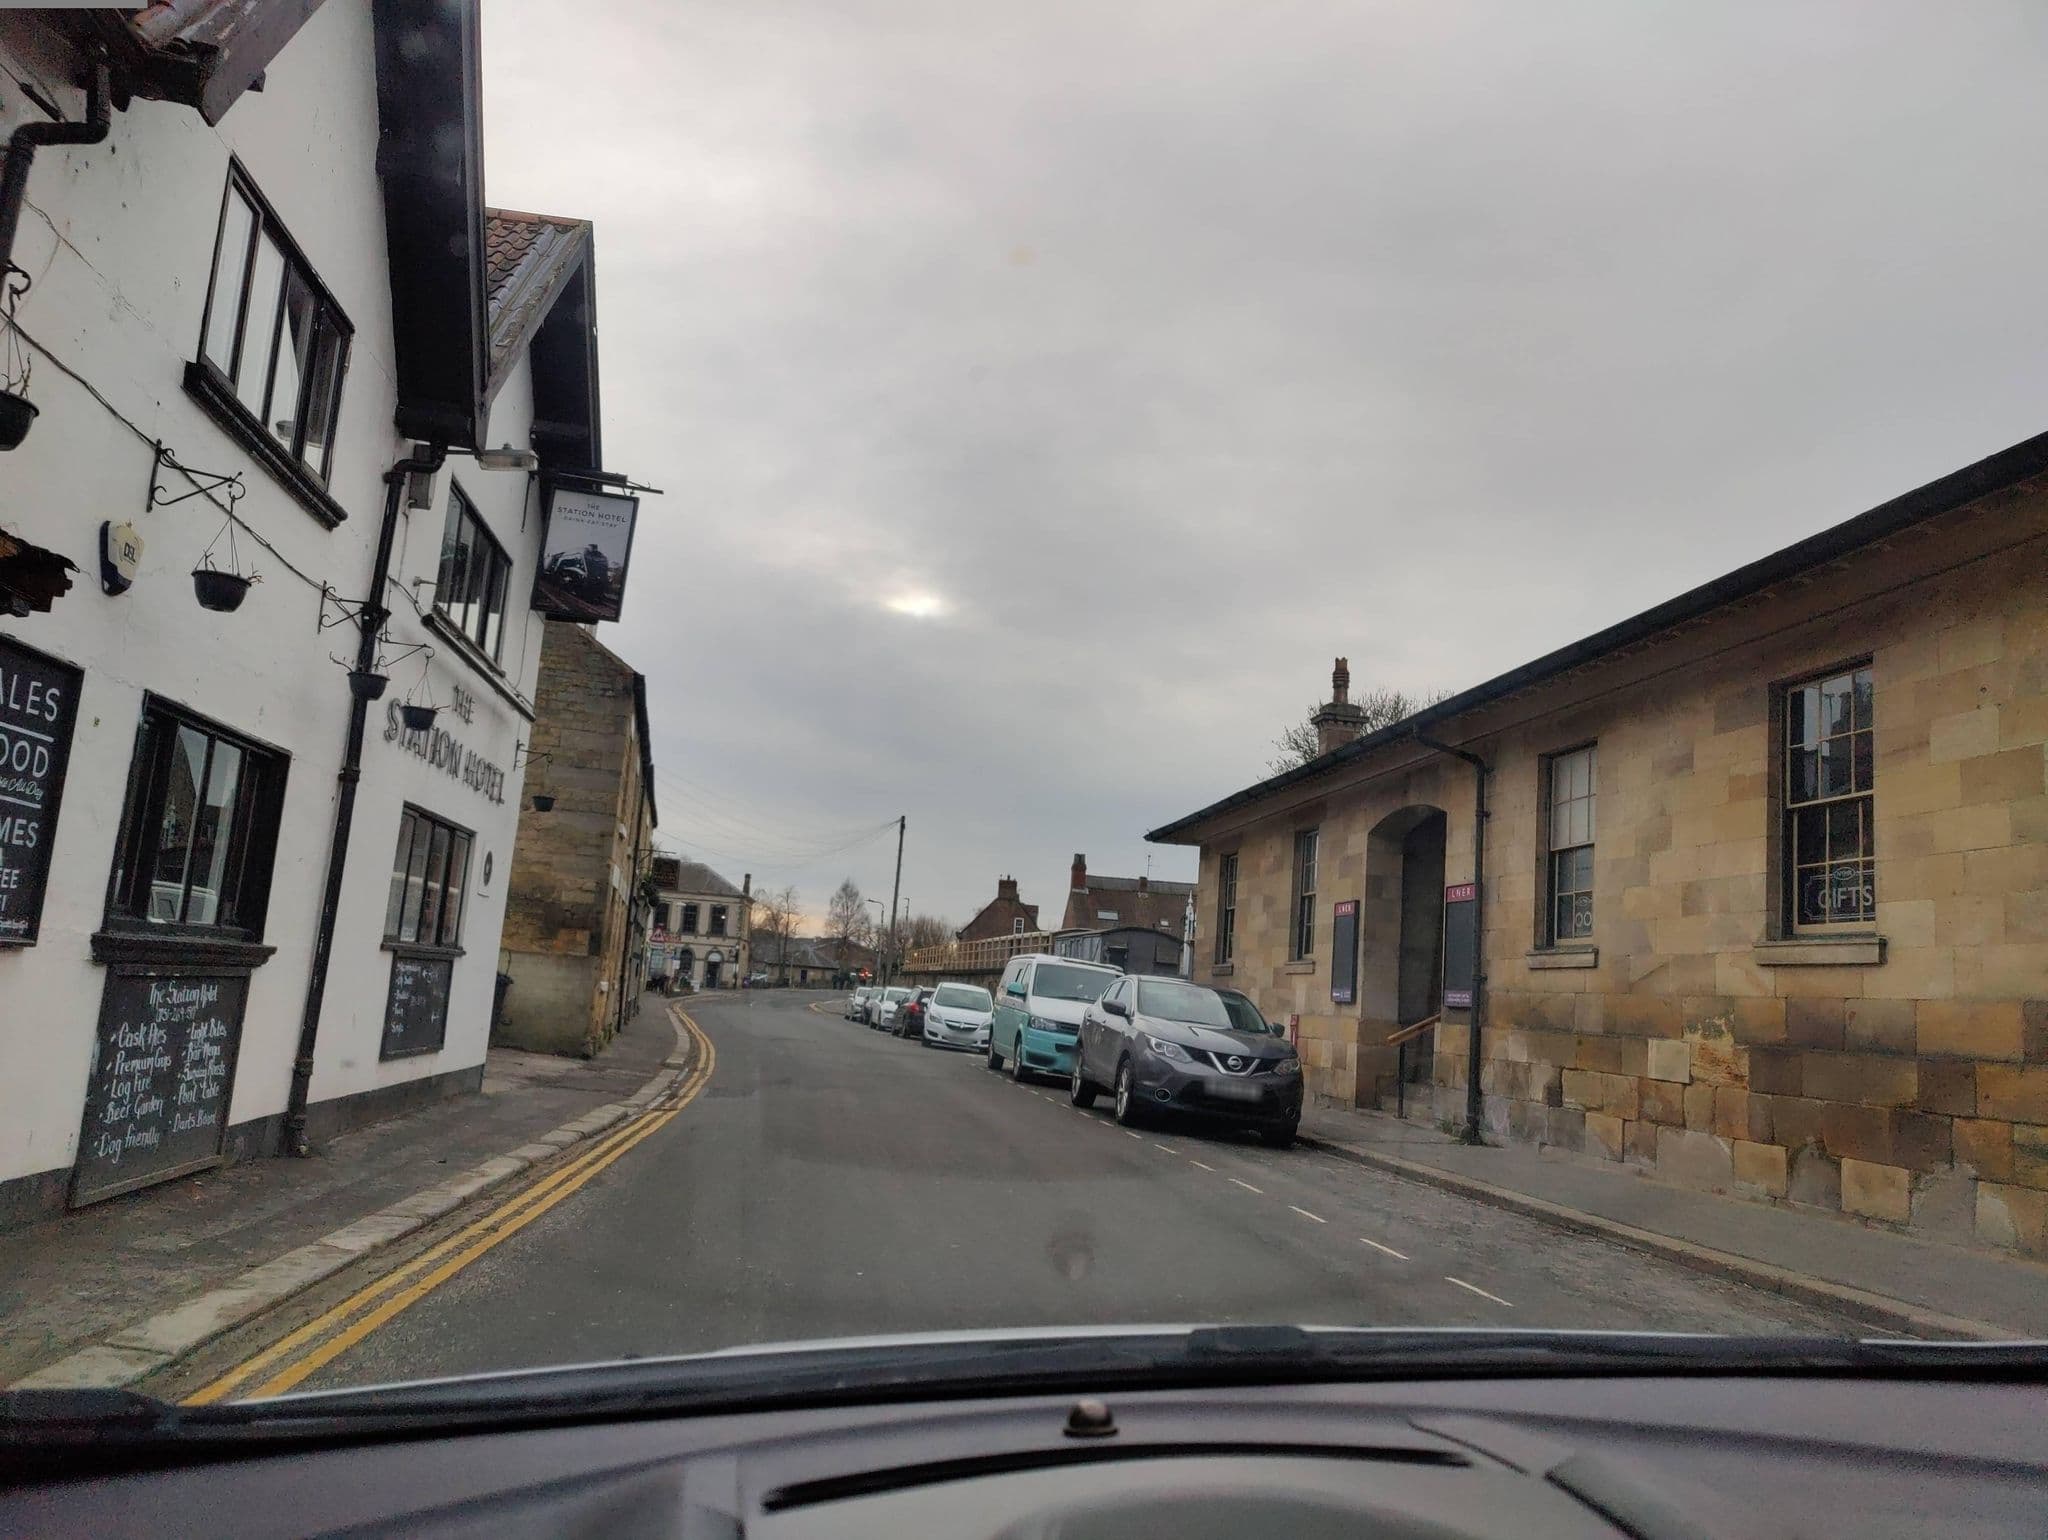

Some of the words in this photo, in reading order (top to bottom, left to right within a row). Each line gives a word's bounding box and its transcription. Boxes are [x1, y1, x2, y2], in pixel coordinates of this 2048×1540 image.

[557, 506, 595, 518] STATION
[598, 513, 627, 523] HOTEL
[587, 503, 600, 511] THE
[452, 685, 474, 725] THE
[463, 750, 505, 805] HOTEL
[1818, 885, 1873, 908] GIFTS
[166, 981, 200, 1009] Station
[118, 1022, 146, 1051] Cask
[115, 1050, 154, 1076] Premium
[110, 1078, 131, 1104] Log
[133, 1073, 152, 1093] Fire
[178, 1081, 198, 1105] Pool
[104, 1101, 132, 1124] Beer
[134, 1094, 163, 1120] Garden
[172, 1113, 196, 1132] Darts
[97, 1132, 121, 1164] Dog
